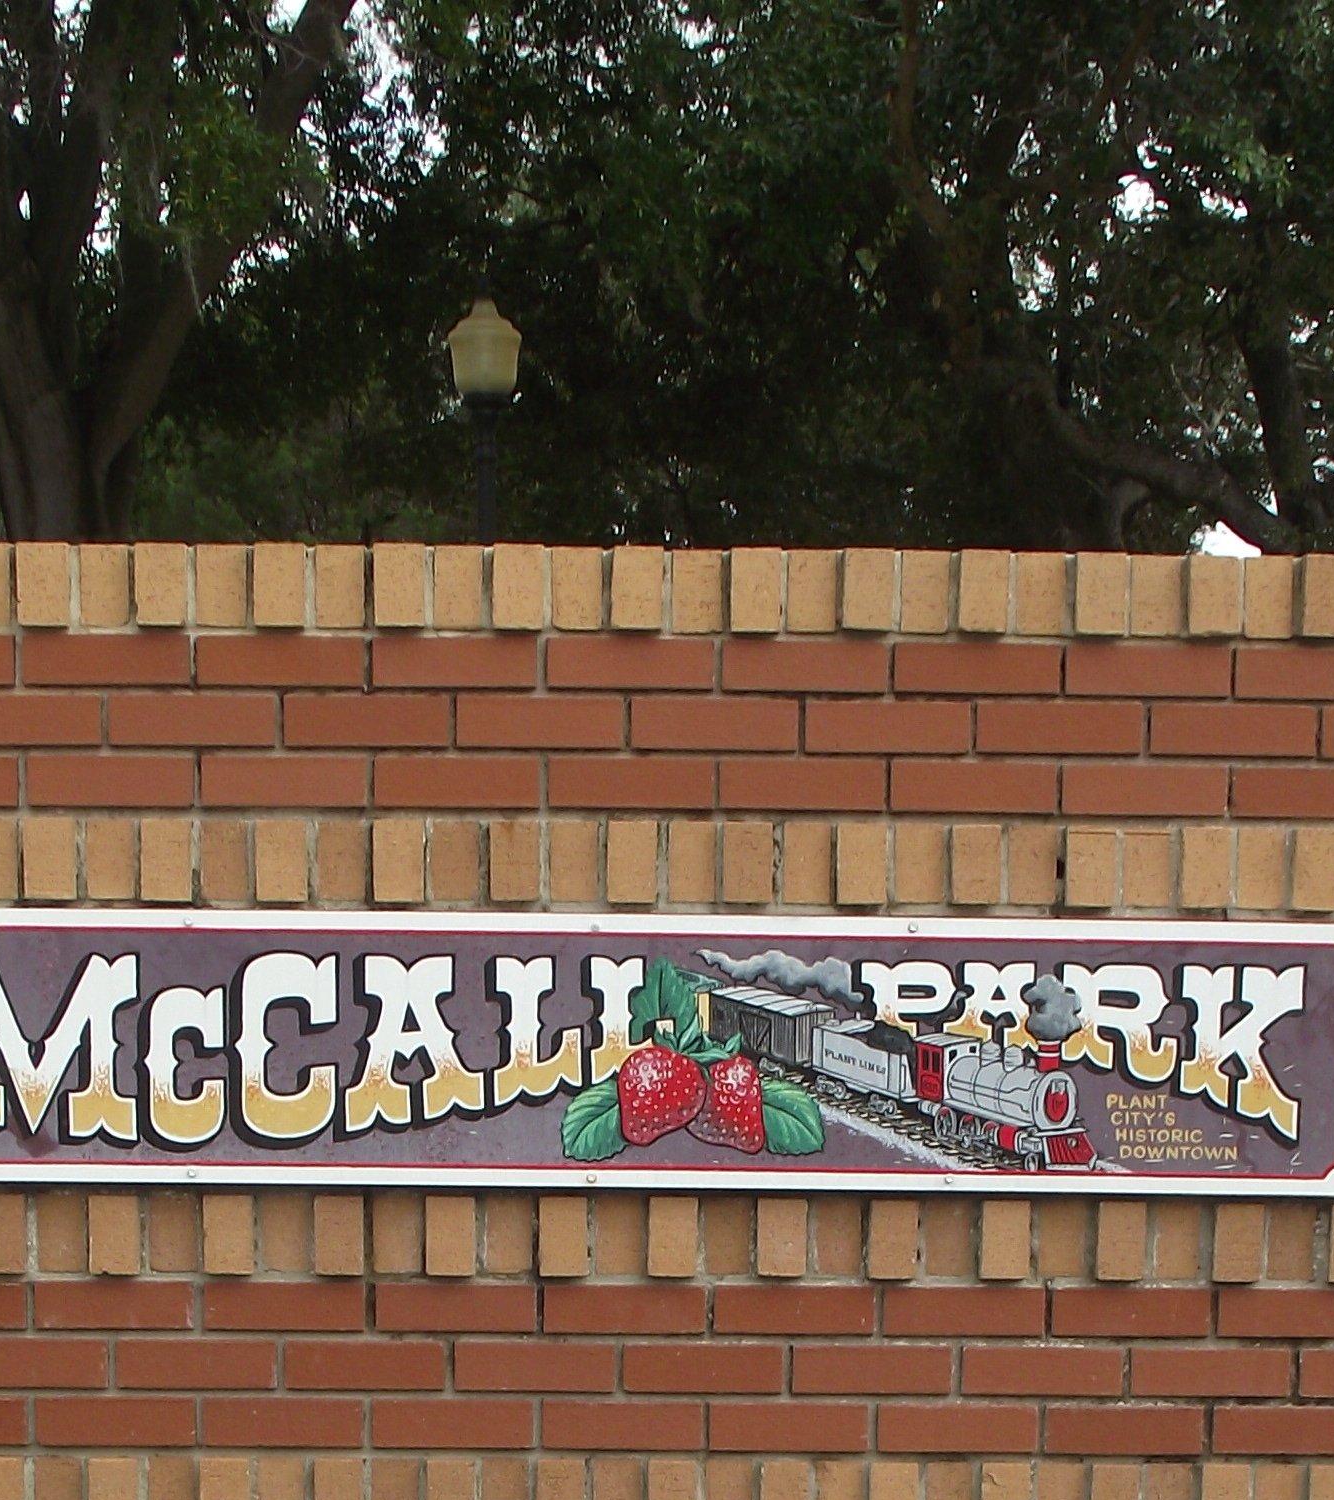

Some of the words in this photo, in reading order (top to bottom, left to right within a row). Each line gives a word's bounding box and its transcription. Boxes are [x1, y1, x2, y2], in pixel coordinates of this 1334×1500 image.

[824, 1048, 857, 1066] PLANT
[859, 961, 1307, 1145] PARK
[1105, 1093, 1168, 1109] PLANT
[1110, 1111, 1176, 1126] CITY'S
[1115, 1128, 1204, 1144] HISTORIC
[1119, 1145, 1238, 1161] DOWNTOWN
